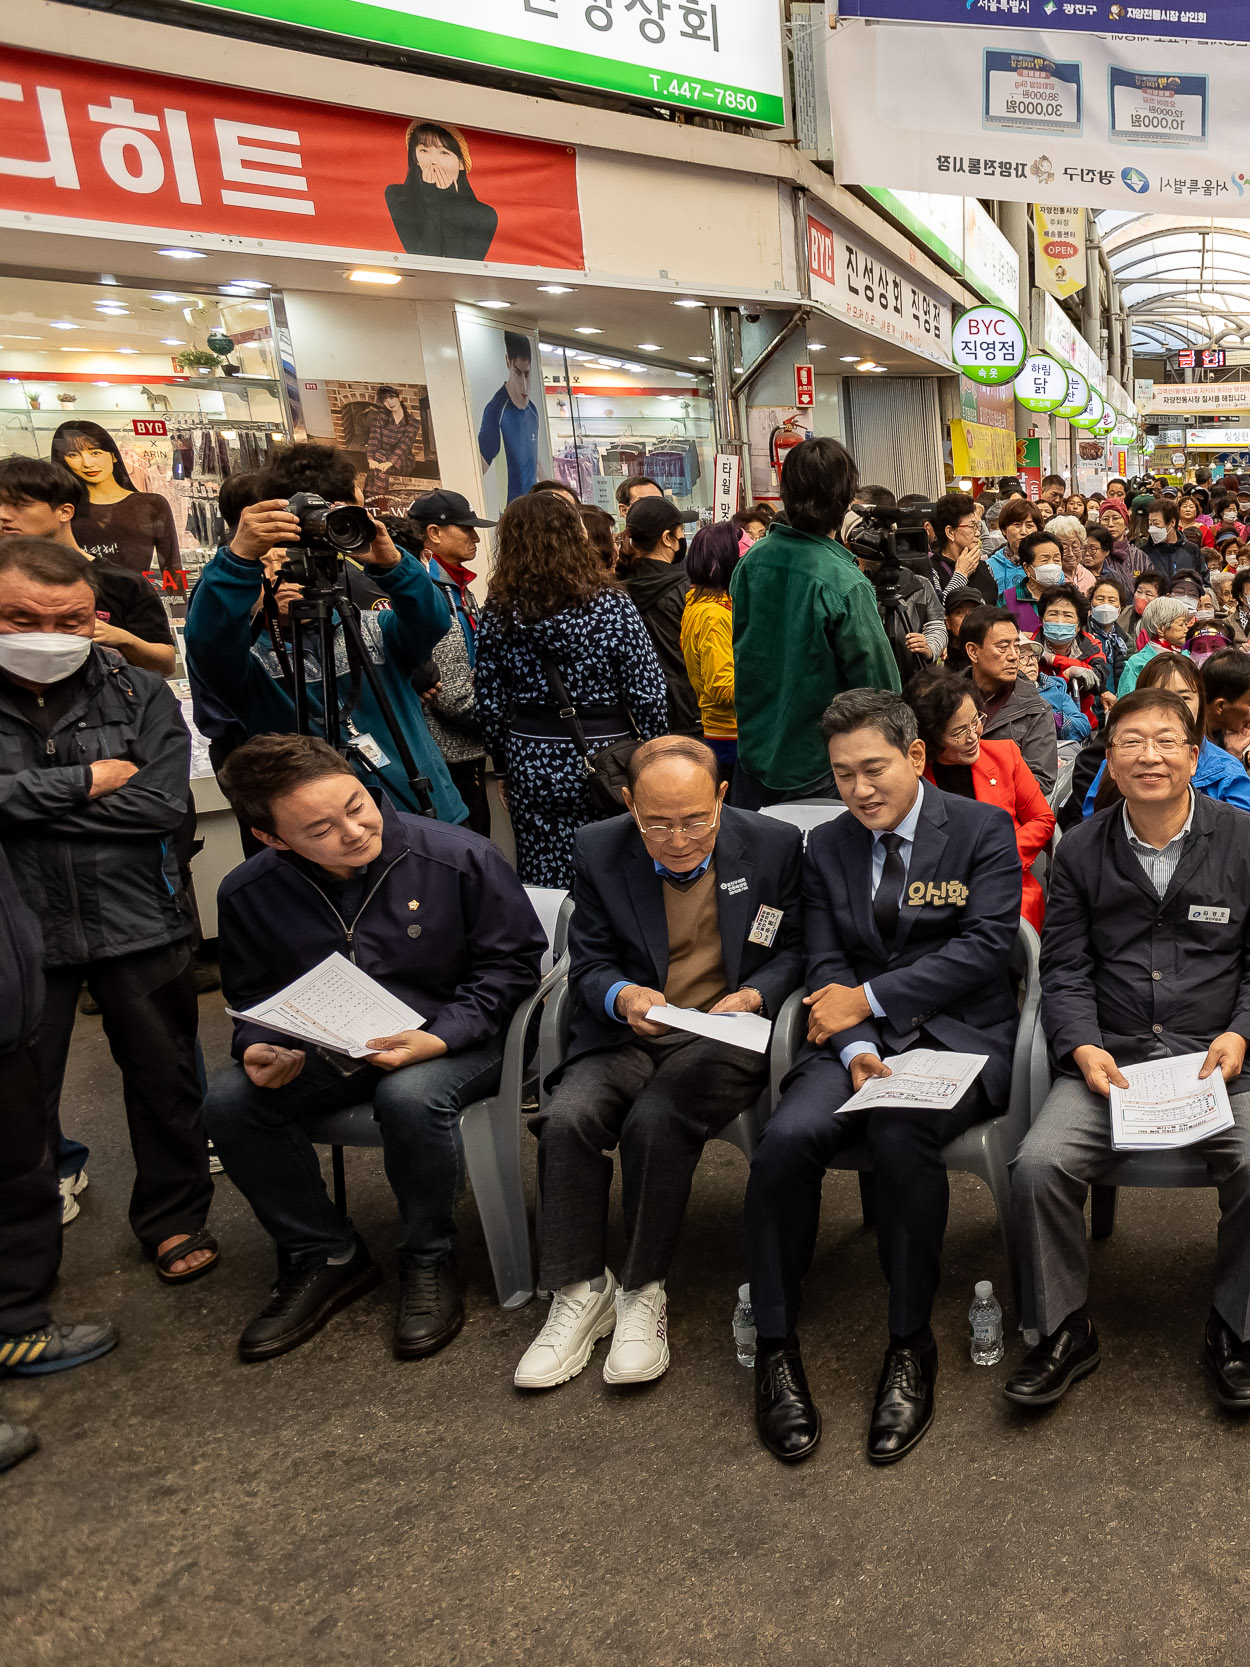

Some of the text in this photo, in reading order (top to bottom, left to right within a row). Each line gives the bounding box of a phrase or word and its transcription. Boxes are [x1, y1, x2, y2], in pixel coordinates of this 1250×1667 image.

[1063, 4, 1097, 16] 광진구
[1127, 7, 1207, 23] 자양전통시장 상인회
[649, 73, 758, 113] T.447-7850
[1039, 206, 1079, 215] 자양전통시장
[1043, 230, 1076, 239] 배송콜센터
[811, 226, 832, 279] BYC
[1048, 246, 1074, 255] OPEN
[845, 244, 903, 319] 진성상회
[911, 287, 941, 340] 직영점
[968, 319, 1006, 336] BYC
[960, 340, 1016, 362] 직영점
[977, 368, 999, 379] 속옷
[1031, 363, 1051, 376] 하림
[1033, 377, 1049, 395] 닭
[1163, 395, 1200, 404] 자양전통시장
[136, 421, 164, 434] BYC
[143, 450, 167, 458] ARIN
[721, 462, 733, 496] 타월
[907, 880, 969, 907] 오신환
